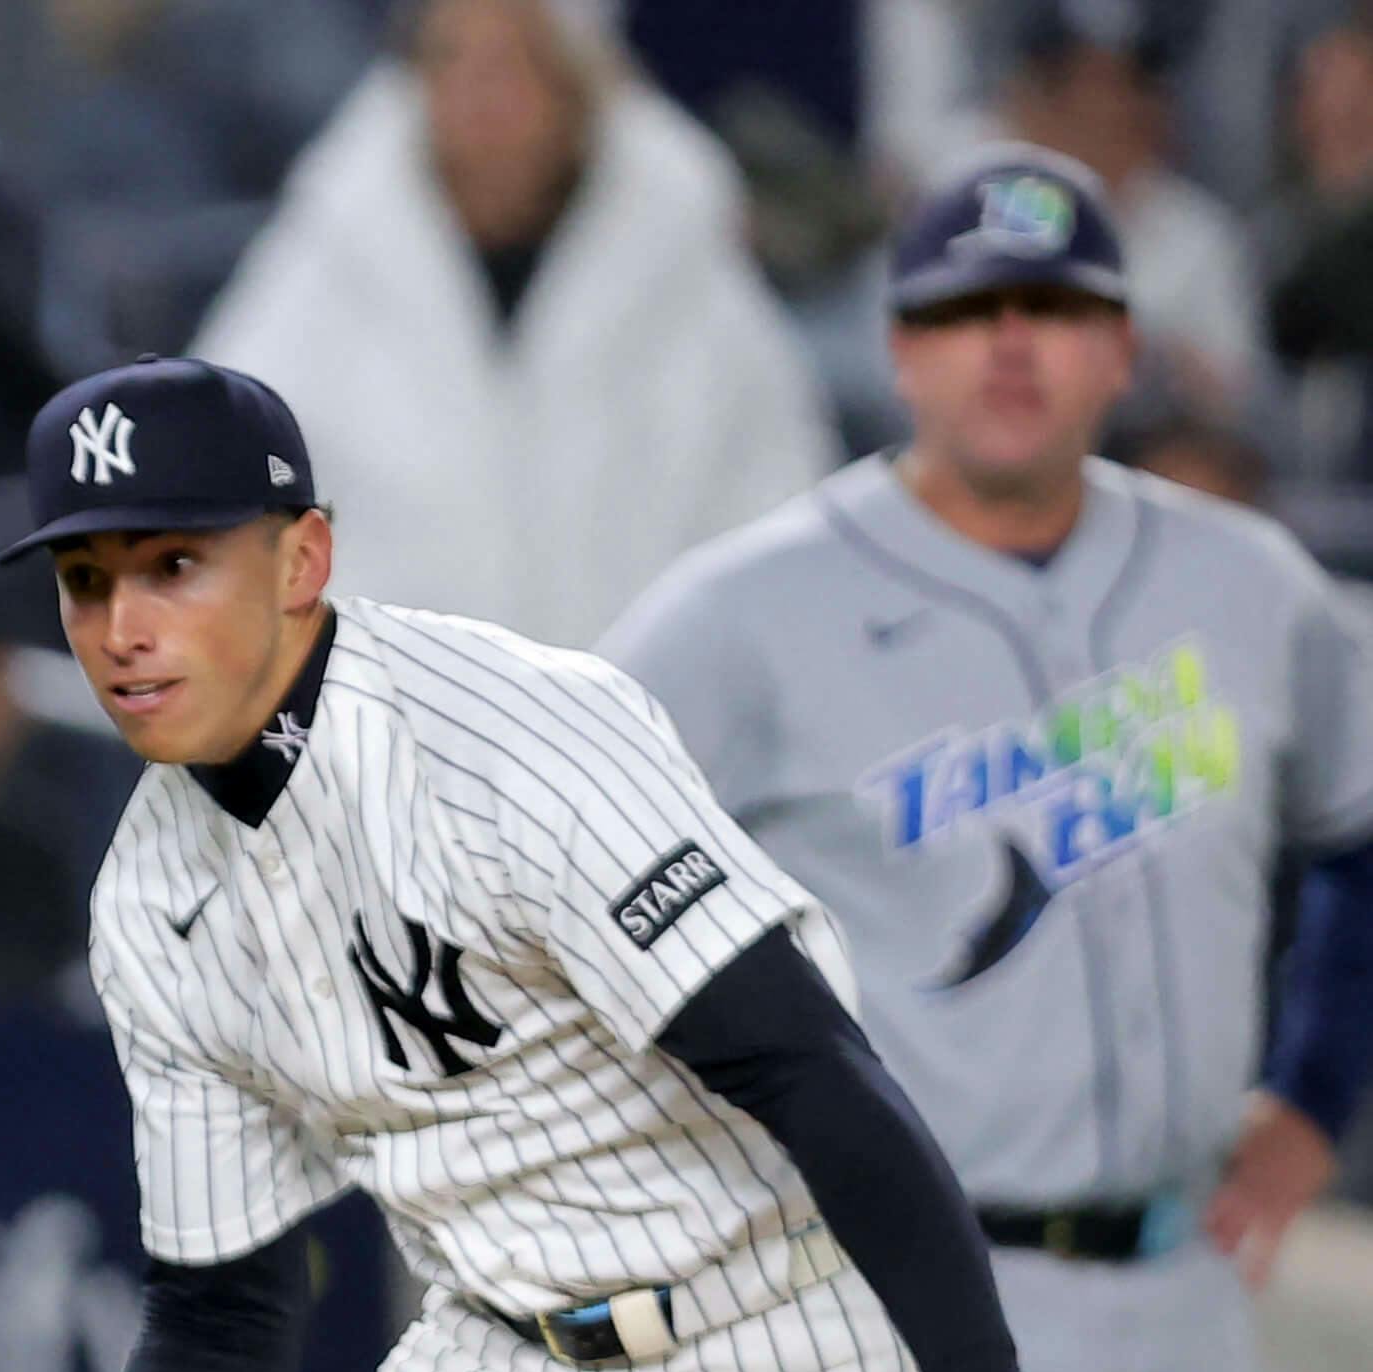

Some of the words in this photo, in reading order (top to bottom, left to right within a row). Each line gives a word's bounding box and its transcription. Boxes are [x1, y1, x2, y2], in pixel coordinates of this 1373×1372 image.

[69, 402, 136, 485] NY
[857, 634, 1201, 862] TAMPA
[618, 848, 726, 941] STARR
[348, 909, 505, 1077] NY
